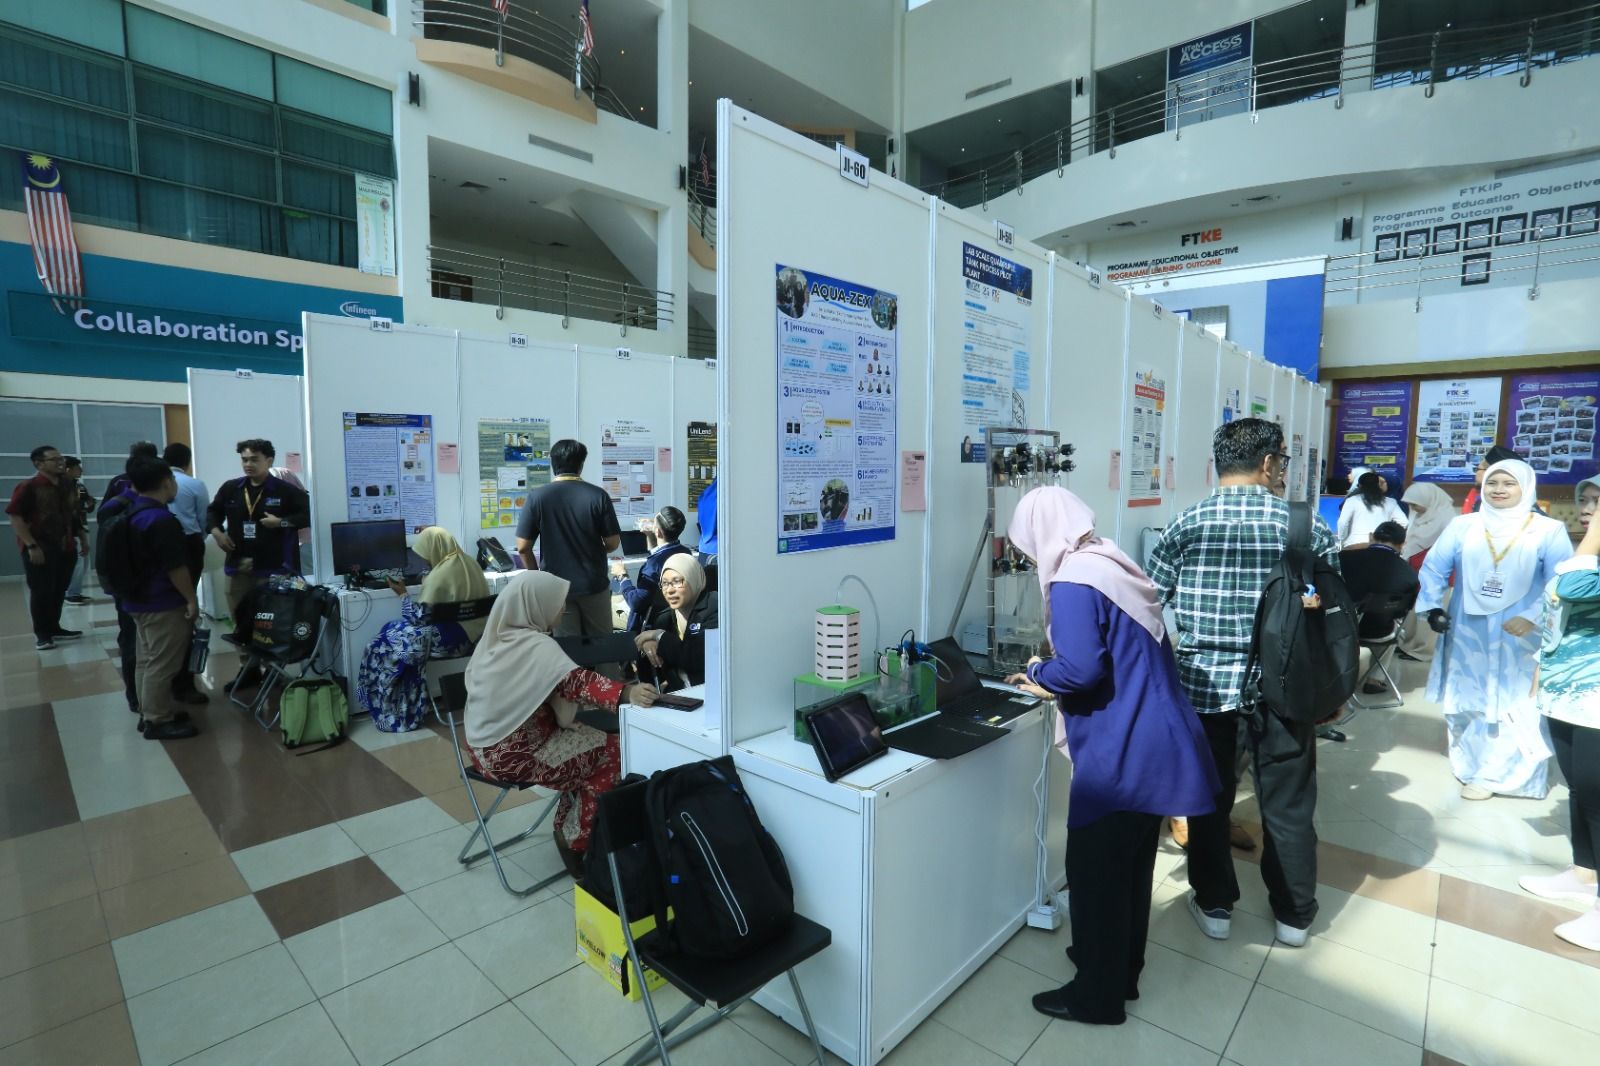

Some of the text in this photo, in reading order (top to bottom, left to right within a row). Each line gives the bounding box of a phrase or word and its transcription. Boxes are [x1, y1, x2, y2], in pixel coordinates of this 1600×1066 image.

[1180, 33, 1242, 65] ACCESS
[843, 156, 866, 180] JI-60
[1373, 177, 1600, 223] Programme Education Objective
[1460, 181, 1503, 197] FTKIP
[1372, 204, 1513, 233] Programme Outcome
[1181, 228, 1222, 247] FTKE
[965, 246, 975, 257] LAB
[975, 249, 991, 263] SCALE
[1107, 246, 1239, 272] PROGRAMME EDUCATIONAL OBJECTIVE
[965, 267, 981, 280] PLANT
[1107, 268, 1150, 281] PROGRAMME
[1186, 258, 1222, 269] OUTCOME
[810, 281, 872, 309] AQUA-ZEX
[74, 308, 268, 346] Collaboration
[784, 386, 789, 397] 3
[857, 435, 862, 446] 5
[857, 470, 862, 480] 6
